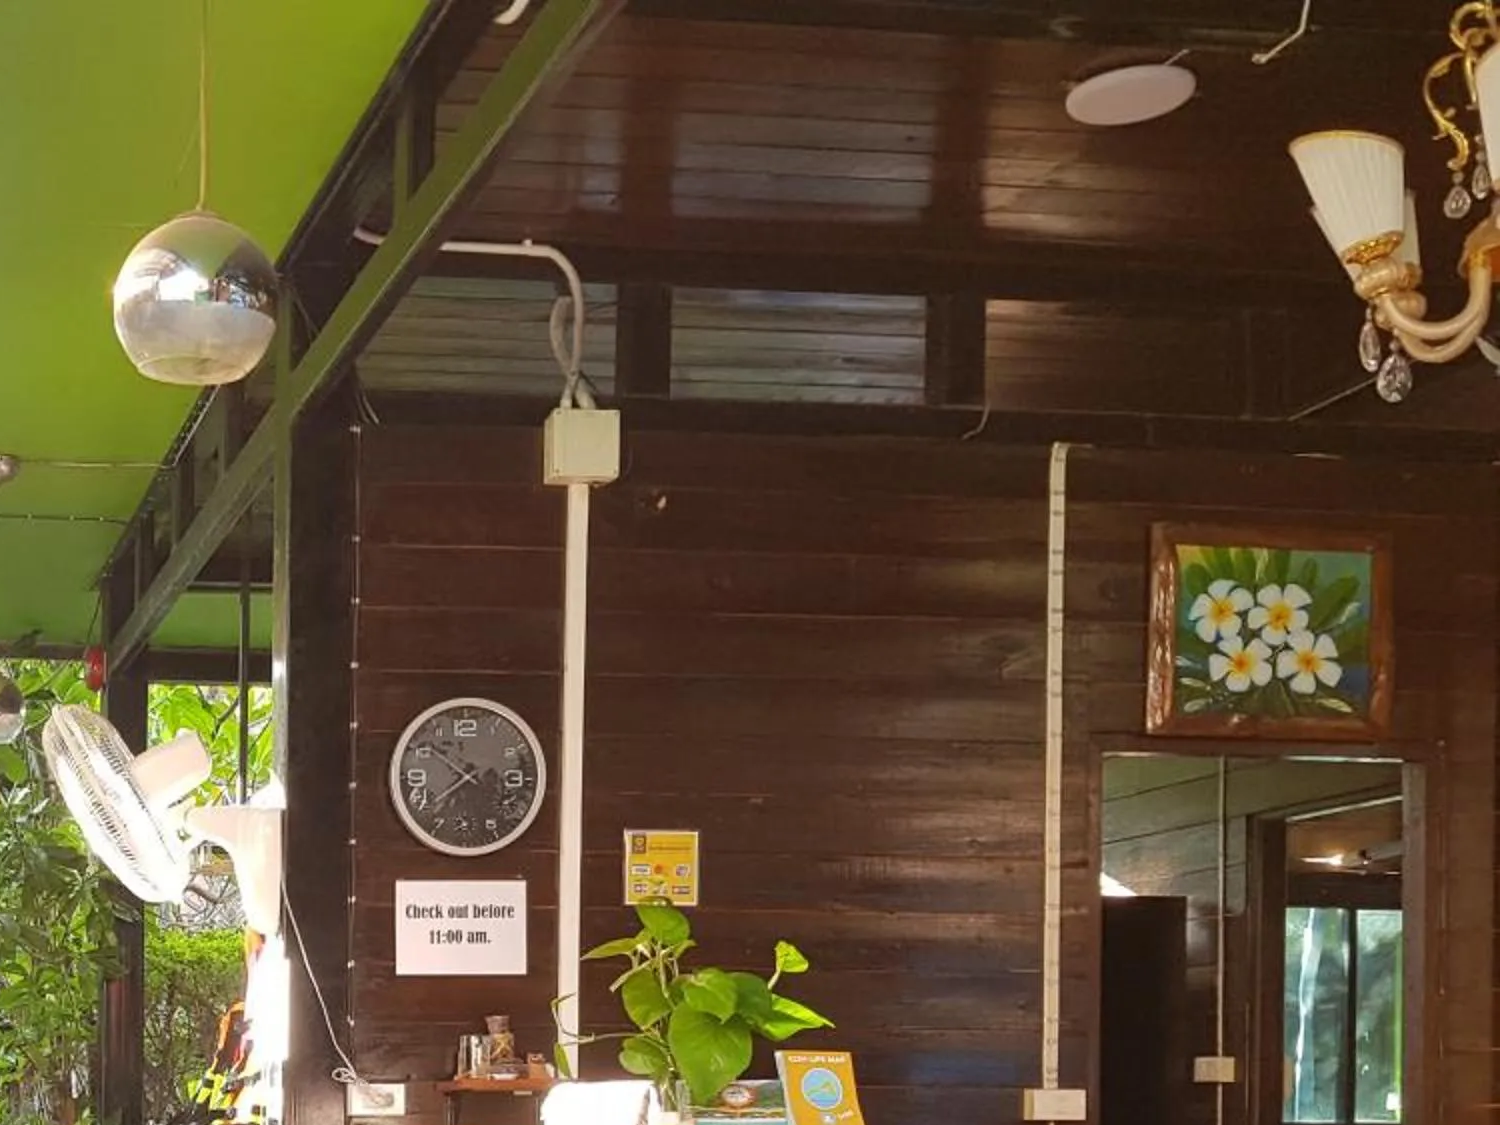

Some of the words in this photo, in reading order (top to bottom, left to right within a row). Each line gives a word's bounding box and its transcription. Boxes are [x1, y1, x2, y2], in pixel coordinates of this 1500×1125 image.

[453, 719, 477, 737] 12
[407, 769, 427, 787] 9
[504, 769, 523, 787] 3
[405, 904, 443, 919] Check
[447, 904, 469, 919] out
[473, 904, 515, 919] before
[429, 929, 463, 944] 11:00
[466, 930, 492, 944] am.
